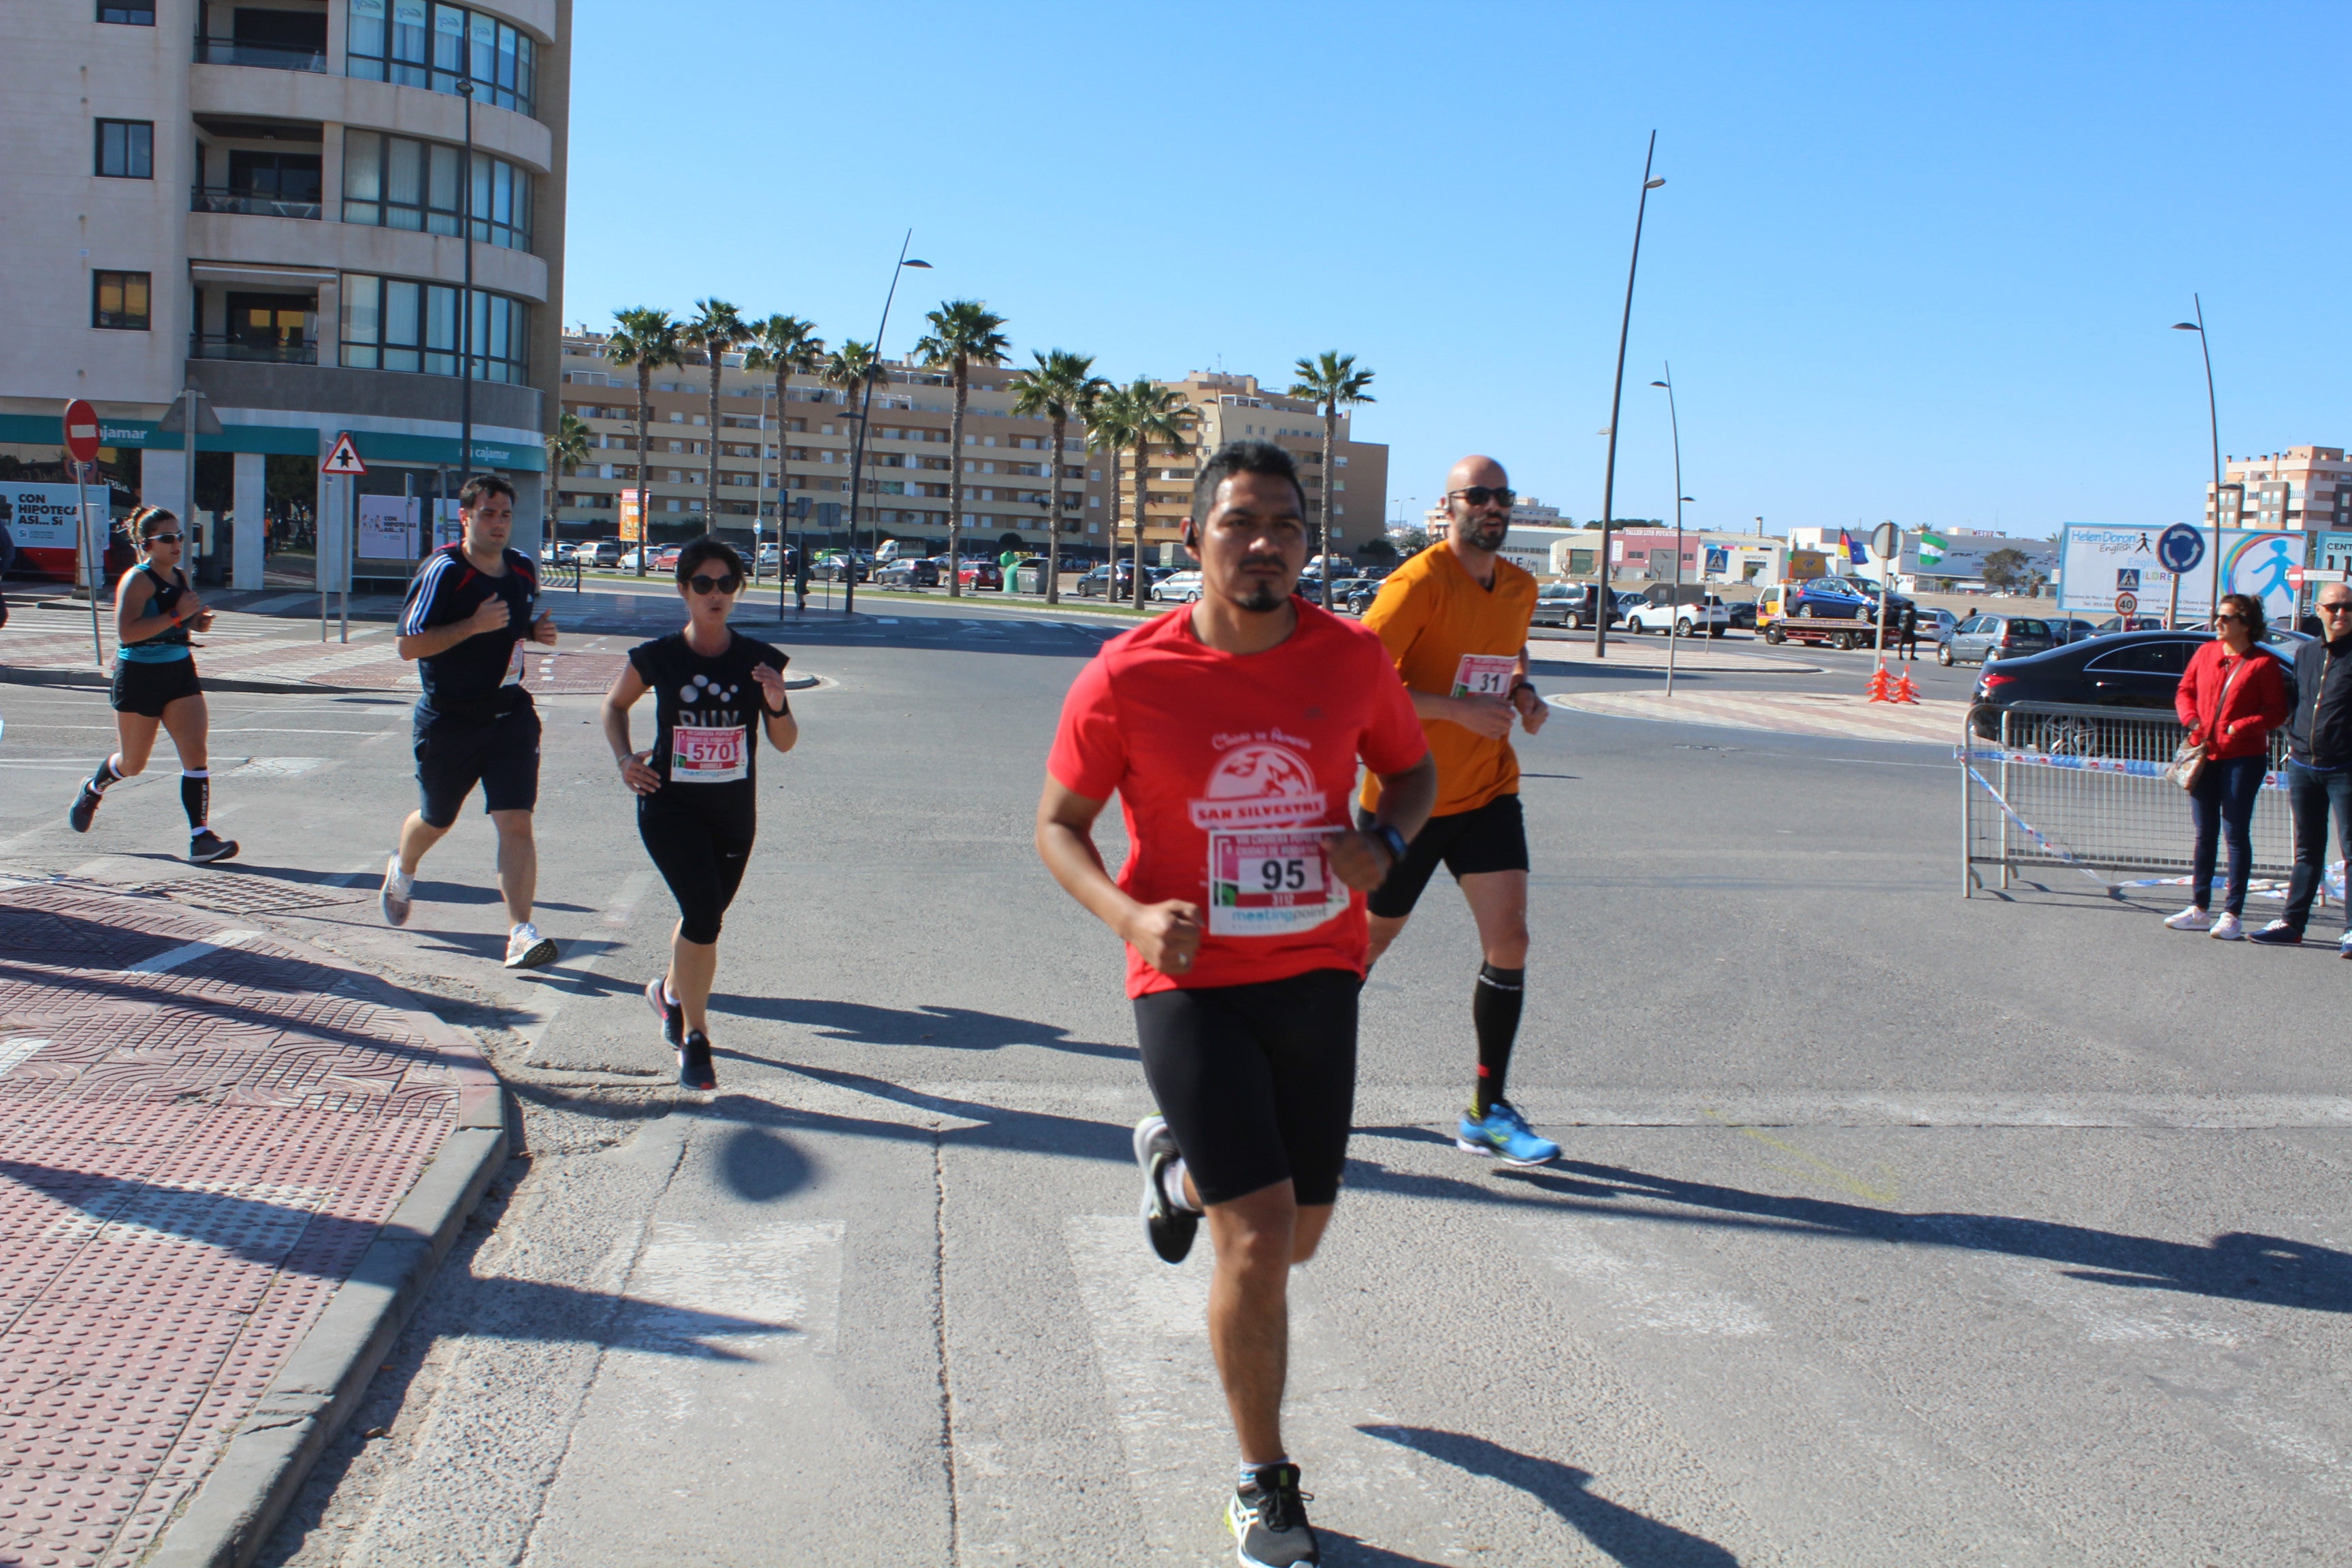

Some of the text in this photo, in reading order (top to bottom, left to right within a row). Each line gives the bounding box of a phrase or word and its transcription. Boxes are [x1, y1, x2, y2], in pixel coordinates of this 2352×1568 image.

[99, 425, 148, 441] jamar
[475, 446, 510, 461] cajamar
[18, 493, 46, 504] CON
[18, 504, 77, 515] HIPOTECA
[2072, 531, 2136, 543] Helen Doron
[2100, 543, 2131, 554] English
[2128, 557, 2159, 569] Englis
[2142, 570, 2173, 581] ILDRE
[2119, 600, 2133, 609] 40
[693, 744, 730, 760] 570
[1198, 808, 1232, 821] SAN
[1262, 859, 1305, 891] 95
